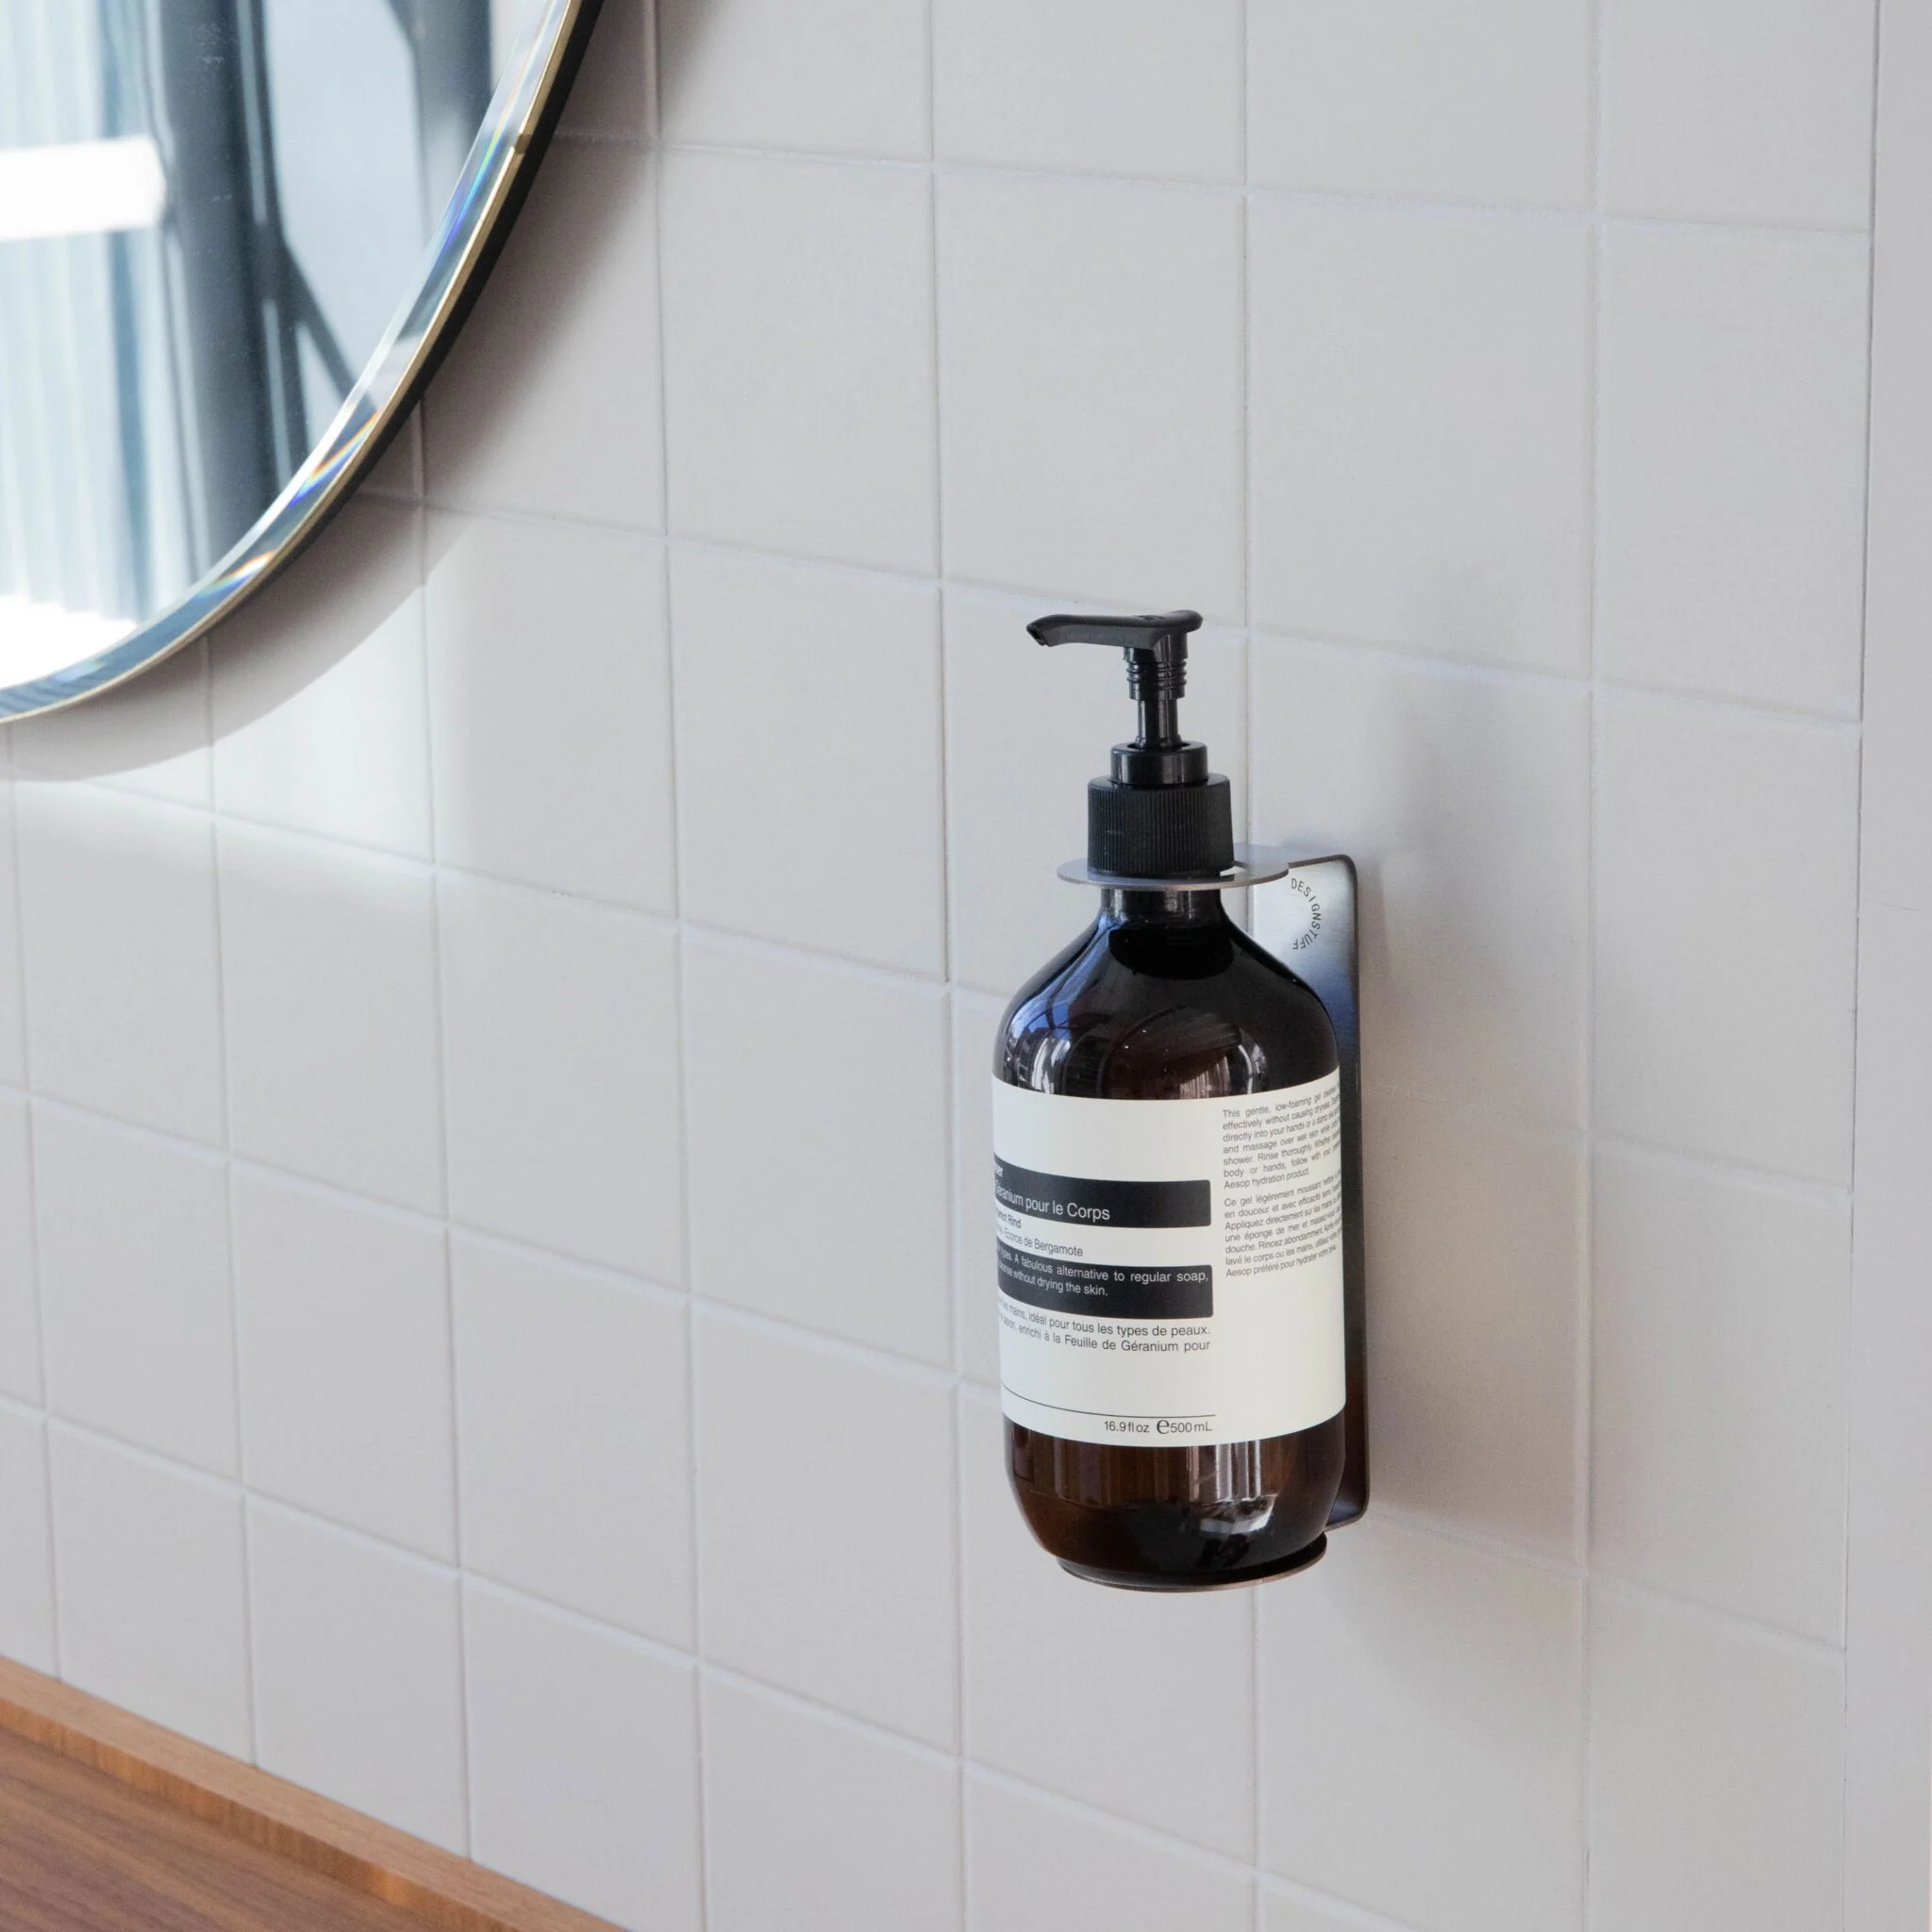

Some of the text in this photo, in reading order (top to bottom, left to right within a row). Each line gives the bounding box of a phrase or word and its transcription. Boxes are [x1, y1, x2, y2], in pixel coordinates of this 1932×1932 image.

[1291, 878, 1321, 950] DESIGNSTUFF
[1223, 1109, 1240, 1118] This
[1245, 1107, 1270, 1117] gentle,
[1275, 1096, 1311, 1110] low-foaming
[1223, 1119, 1263, 1130] effectively
[1266, 1114, 1290, 1124] without
[1291, 1108, 1313, 1120] causing
[1223, 1132, 1252, 1141] directly
[1255, 1129, 1268, 1139] into
[1270, 1127, 1285, 1139] your
[1287, 1124, 1304, 1132] hands
[1243, 1141, 1276, 1152] massage
[1280, 1138, 1294, 1146] over
[1297, 1134, 1307, 1142] wet
[1224, 1158, 1254, 1166] shower.
[1257, 1152, 1278, 1161] Rinse
[1224, 1168, 1243, 1177] body
[1291, 1158, 1307, 1167] follow
[1224, 1180, 1250, 1189] Aesop
[1253, 1172, 1285, 1185] hydration
[1224, 1198, 1237, 1207] Ce
[1241, 1196, 1253, 1208] gel
[1257, 1190, 1294, 1204] légèrement
[1297, 1182, 1322, 1196] moussant
[1025, 1197, 1049, 1212] pour
[1053, 1201, 1063, 1215] le
[1067, 1202, 1110, 1223] Corps
[1239, 1207, 1269, 1217] douceur
[1281, 1201, 1296, 1209] avec
[1008, 1213, 1022, 1229] Rind
[1224, 1219, 1263, 1232] Appliquez
[1266, 1210, 1304, 1225] directement
[1244, 1227, 1273, 1241] éponge
[1276, 1225, 1285, 1235] de
[1288, 1223, 1300, 1231] mer
[1024, 1235, 1033, 1248] de
[1034, 1239, 1083, 1257] Bergamote
[1225, 1244, 1257, 1254] douche.
[1258, 1240, 1283, 1249] Rincez
[1225, 1256, 1242, 1266] lavé
[1253, 1252, 1274, 1263] corps
[1275, 1250, 1284, 1258] ou
[1286, 1246, 1295, 1256] les
[1014, 1254, 1020, 1264] A
[1022, 1257, 1053, 1274] fabulous
[1057, 1265, 1108, 1281] alternative
[1114, 1271, 1124, 1282] to
[1130, 1272, 1171, 1285] regular
[1177, 1273, 1208, 1284] soap,
[1225, 1268, 1252, 1277] Aesop
[1253, 1261, 1279, 1275] préféré
[1281, 1259, 1295, 1271] pour
[1013, 1270, 1036, 1286] without
[1038, 1277, 1064, 1293] drying
[1065, 1283, 1081, 1294] the
[1084, 1285, 1108, 1296] skin.
[1028, 1311, 1047, 1325] idéal
[1050, 1318, 1070, 1331] pour
[1073, 1322, 1093, 1333] tous
[1098, 1324, 1113, 1335] les
[1117, 1325, 1148, 1339] types
[1152, 1325, 1167, 1336] de
[1171, 1326, 1210, 1339] peaux.
[1019, 1324, 1042, 1340] enrichi
[1044, 1330, 1050, 1341] à
[1053, 1332, 1061, 1343] la
[1065, 1335, 1097, 1349] Feuille
[1102, 1340, 1116, 1350] de
[1122, 1340, 1178, 1352] Géranium
[1184, 1341, 1210, 1354] pour
